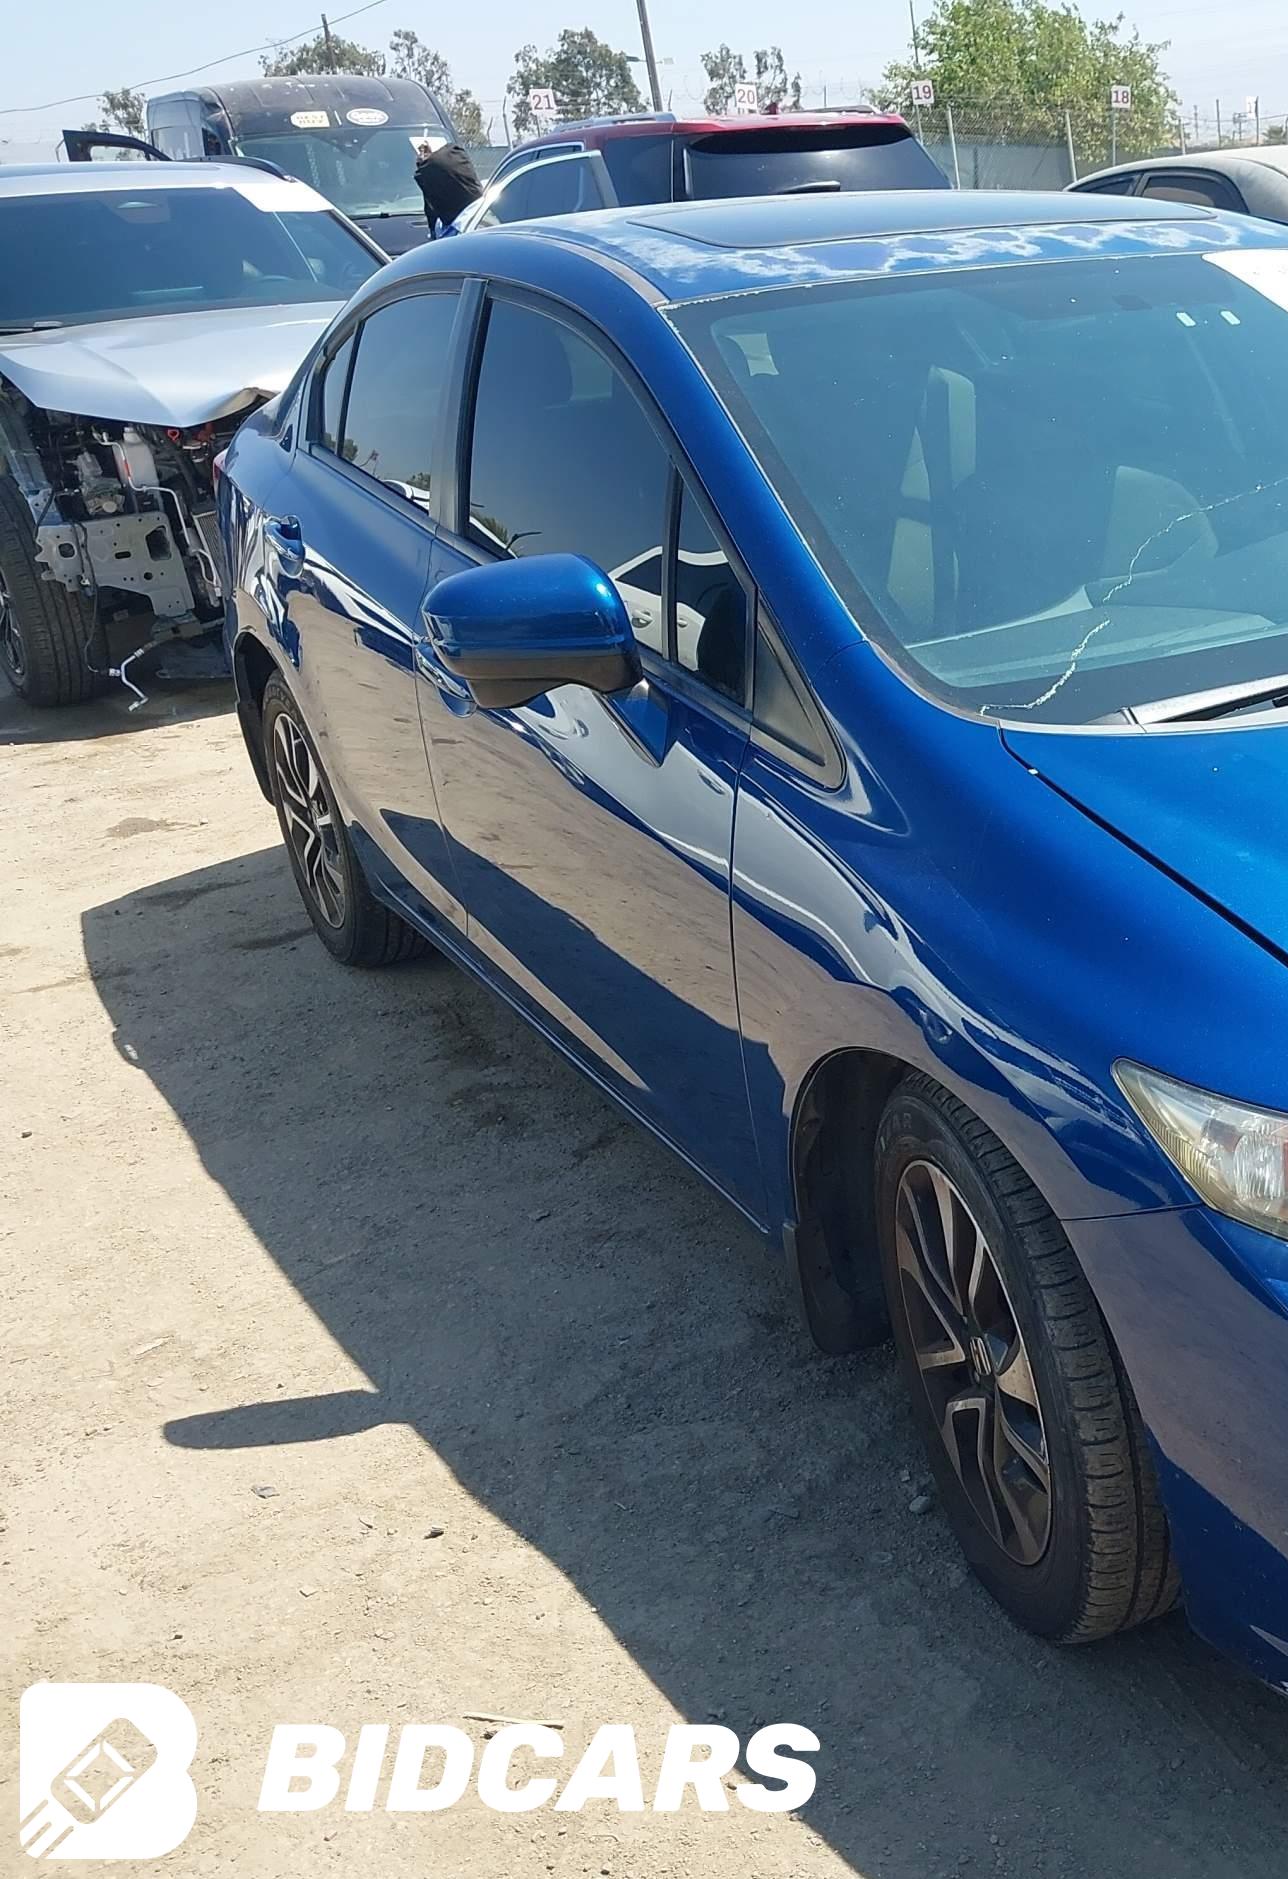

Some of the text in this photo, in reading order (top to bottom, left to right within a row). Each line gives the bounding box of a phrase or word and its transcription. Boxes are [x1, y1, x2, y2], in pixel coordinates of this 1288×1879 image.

[737, 88, 755, 104] 20
[913, 85, 932, 100] 19
[1113, 90, 1130, 104] 18
[532, 94, 555, 110] 21
